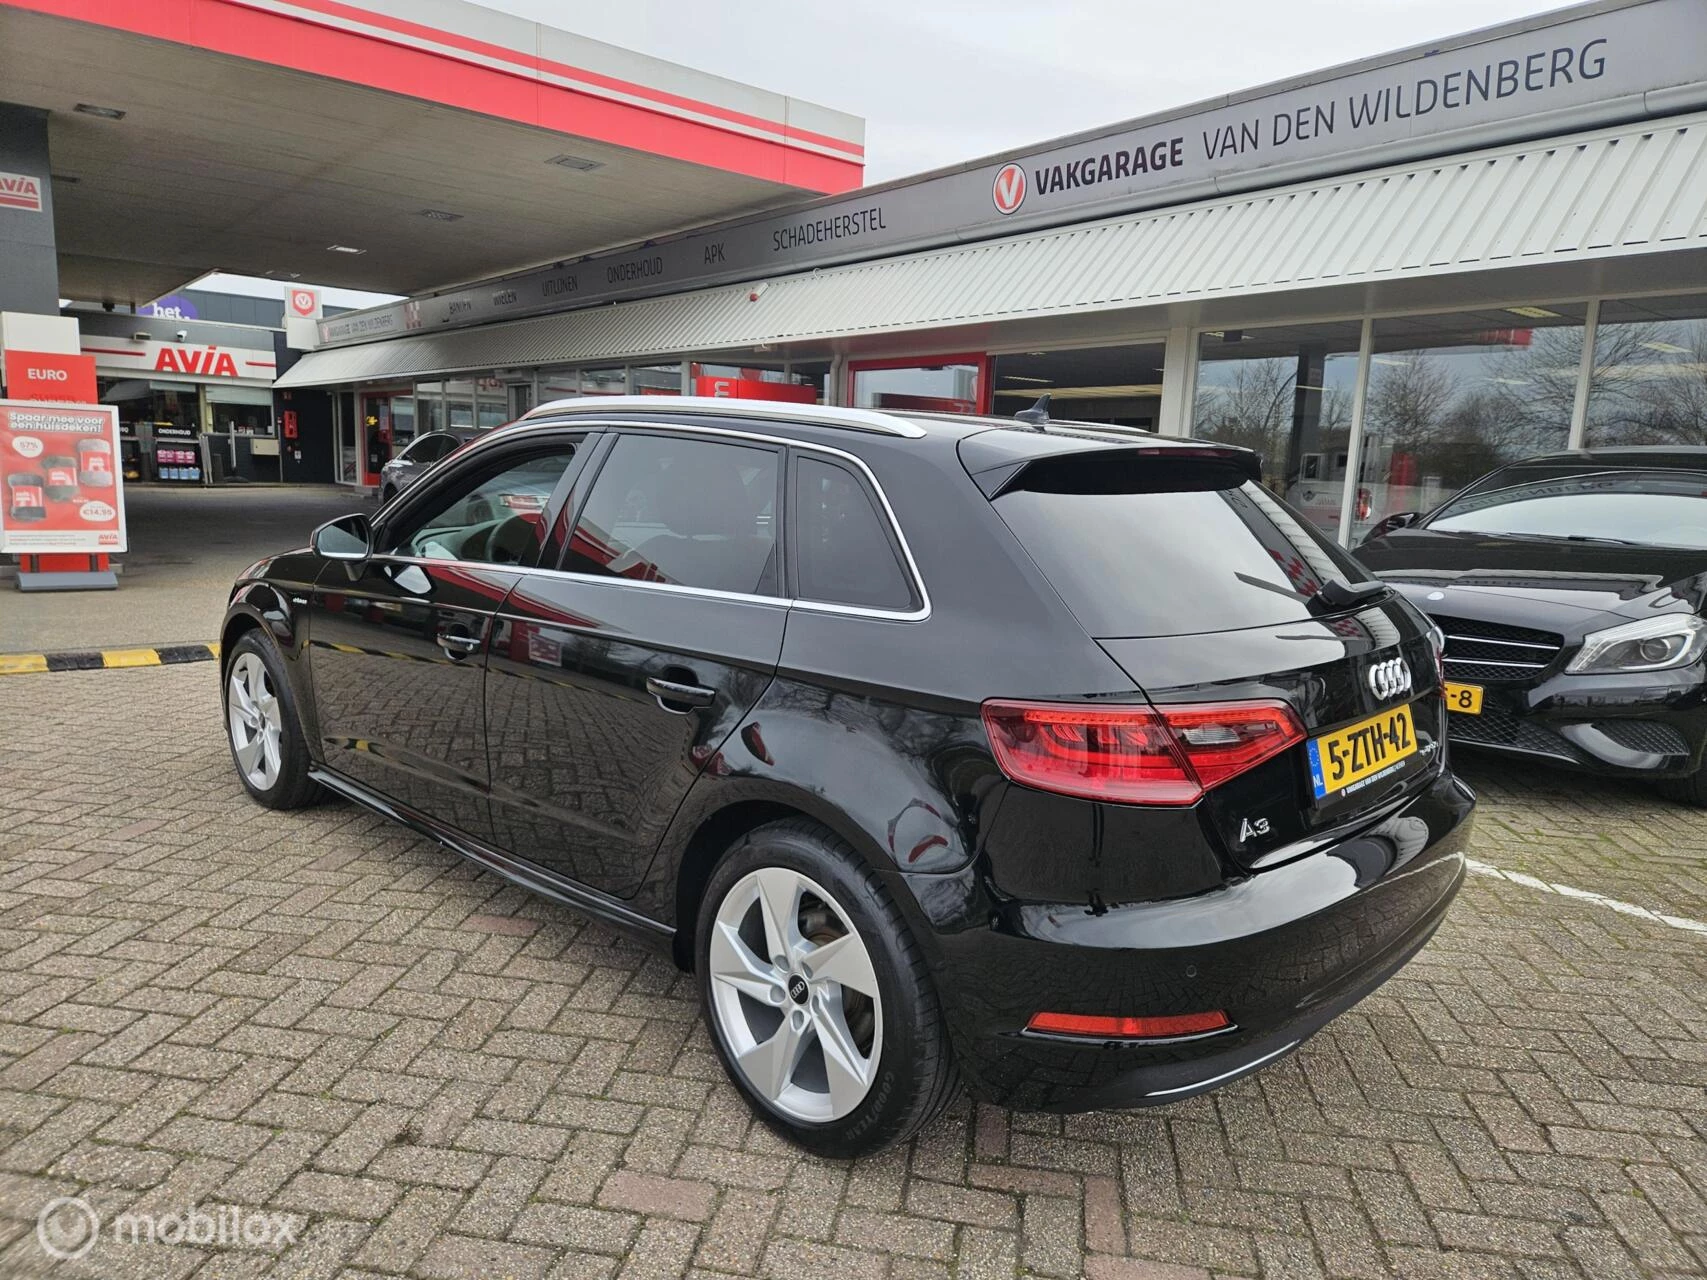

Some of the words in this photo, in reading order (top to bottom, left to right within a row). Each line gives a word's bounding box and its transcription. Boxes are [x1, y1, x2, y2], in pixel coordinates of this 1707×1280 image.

[1035, 137, 1184, 196] VAKGARAGE
[1202, 118, 1260, 160] VAN
[1272, 101, 1337, 147] DEN
[1348, 38, 1608, 129] WILDENBERG
[772, 207, 887, 252] SCHADEHERSTEL
[703, 242, 728, 265] APK
[606, 256, 663, 284] ONDERHOUD
[27, 368, 68, 382] EURO
[9, 412, 46, 423] Spaar
[48, 415, 75, 423] mee
[76, 417, 104, 425] voor
[10, 421, 32, 429] een
[35, 422, 102, 432] huisdeken!
[1328, 712, 1411, 781] 5-ZTH-42
[1312, 774, 1323, 788] NL
[1239, 817, 1270, 843] A3
